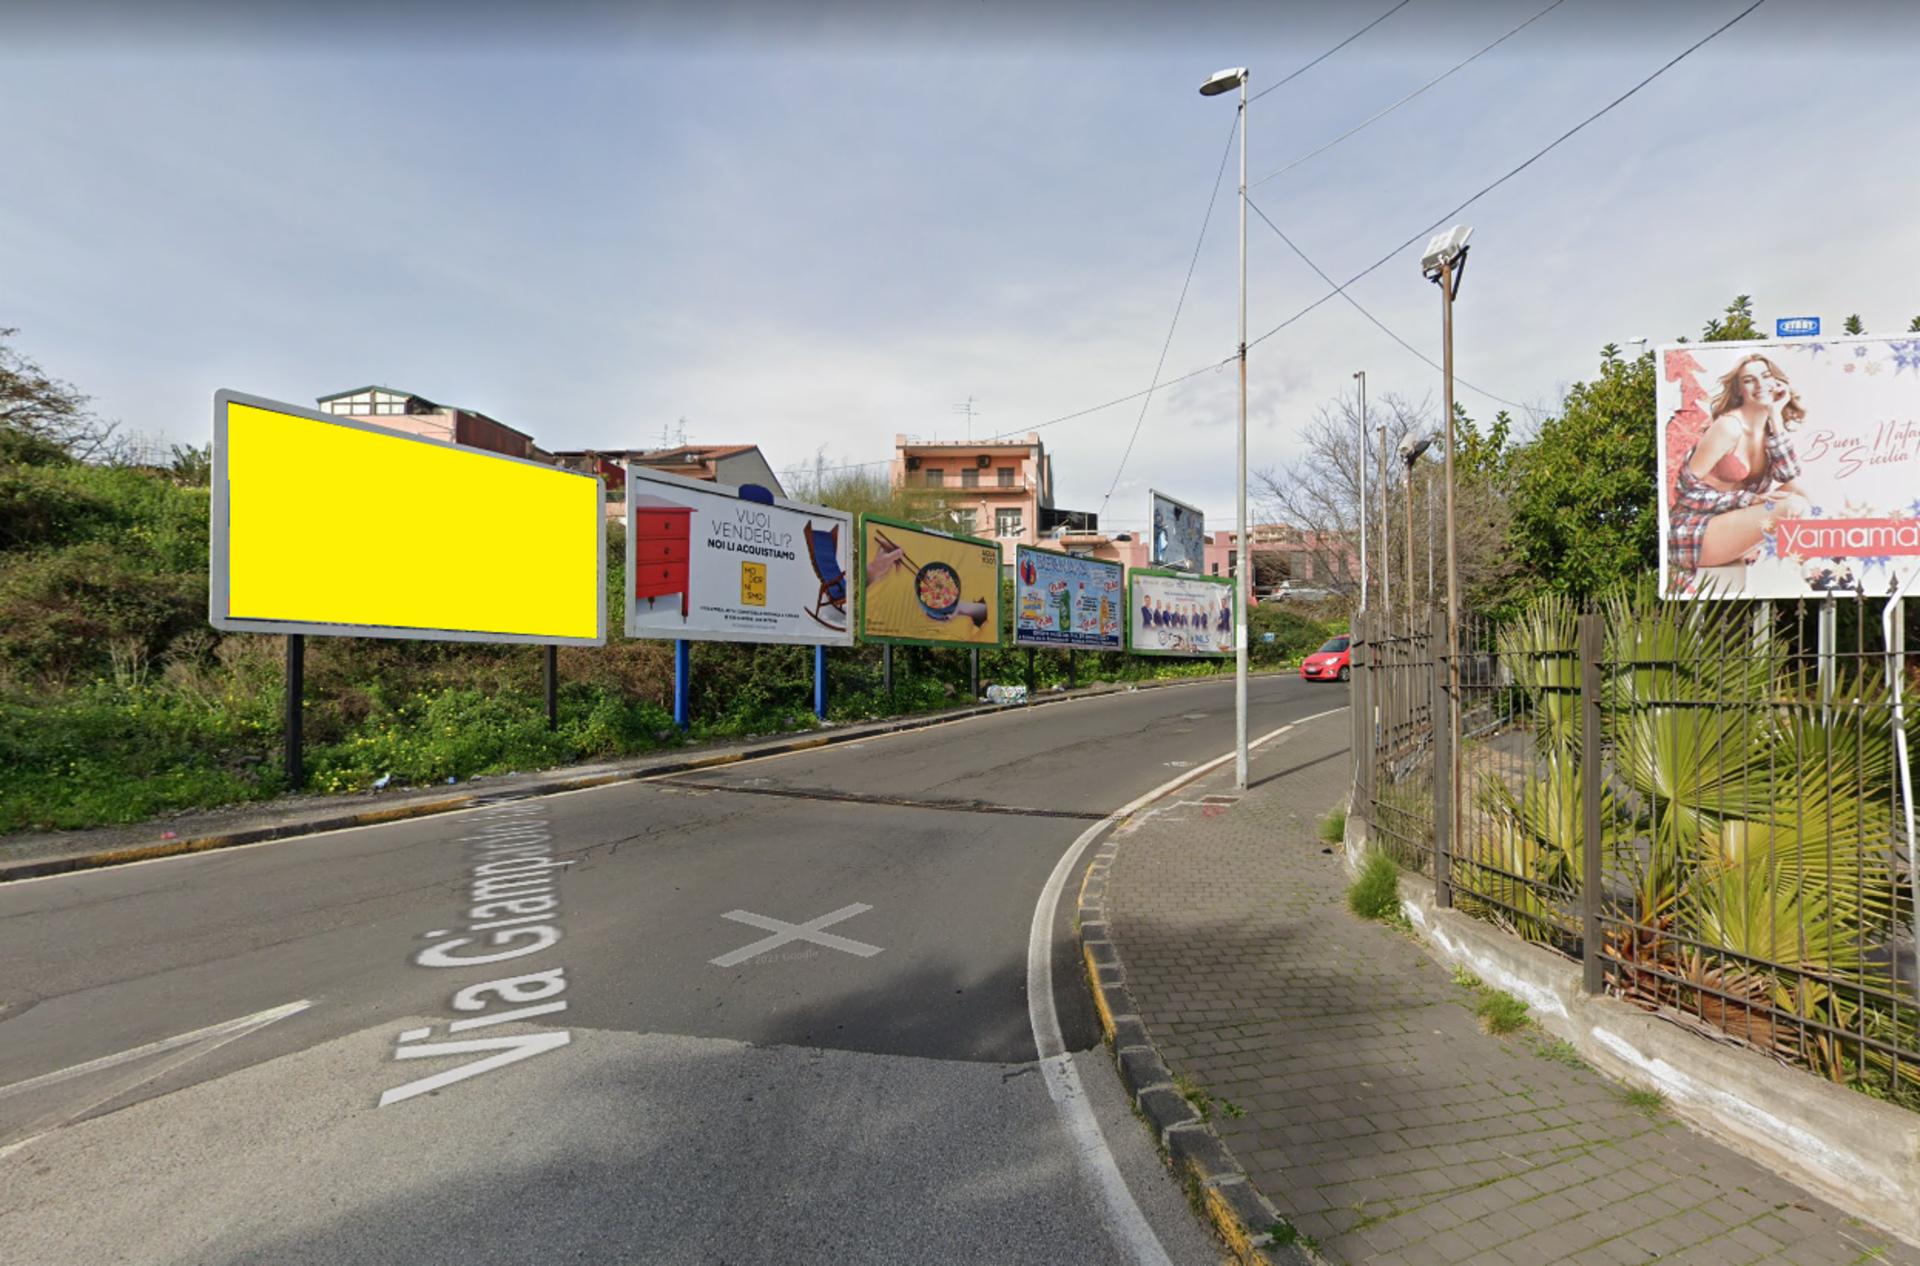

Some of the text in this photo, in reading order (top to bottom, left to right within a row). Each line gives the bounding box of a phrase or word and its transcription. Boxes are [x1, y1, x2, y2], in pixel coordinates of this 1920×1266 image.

[1834, 444, 1909, 480] Sicilia
[736, 507, 770, 528] VUOI
[712, 520, 792, 548] VENDERLI?
[1780, 521, 1920, 553] yamama
[707, 538, 795, 561] NOI LI ACQUISTIAMO
